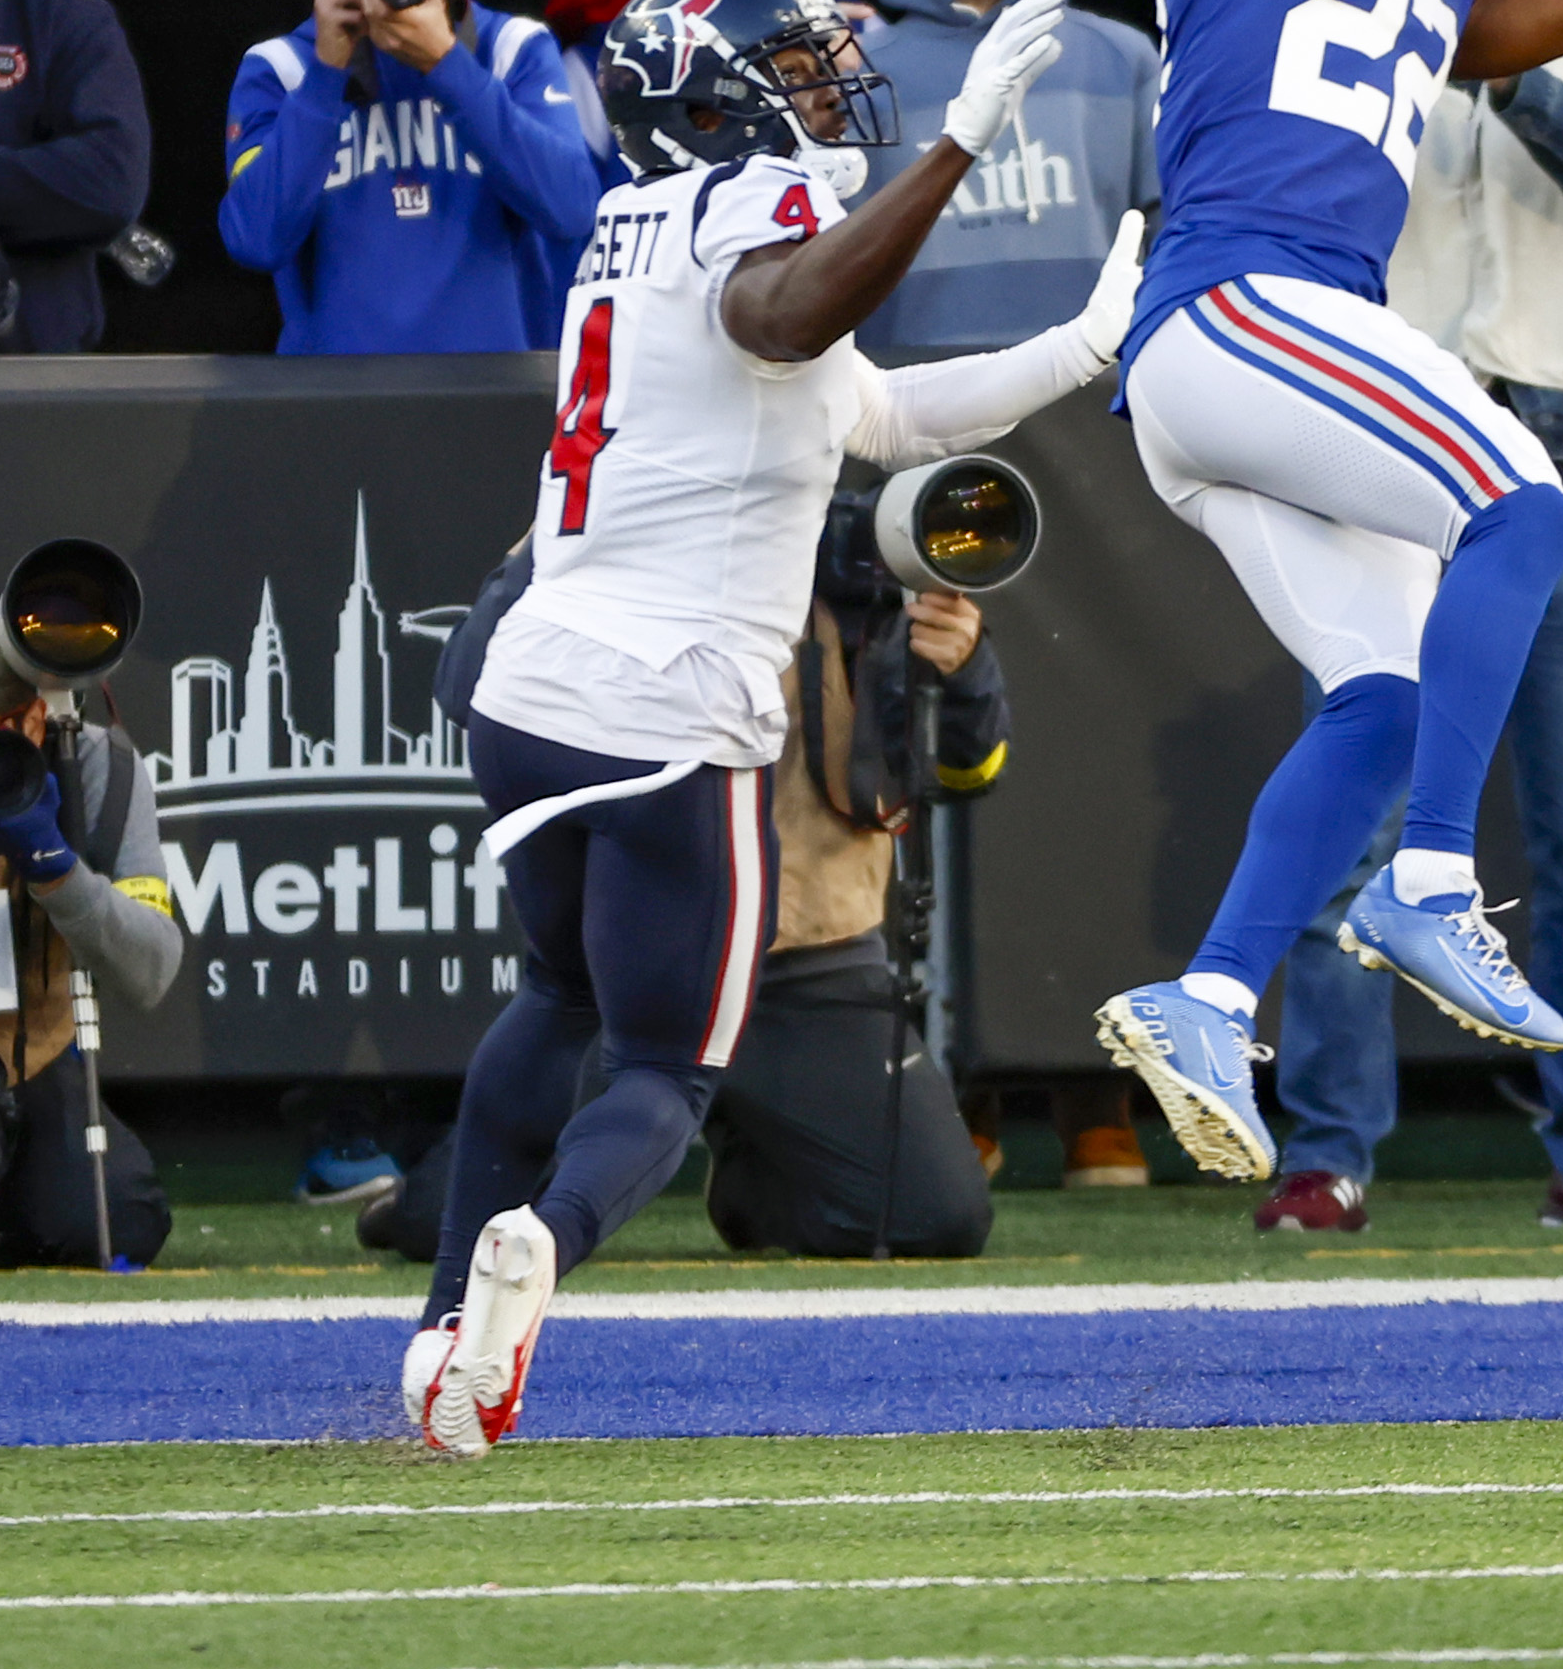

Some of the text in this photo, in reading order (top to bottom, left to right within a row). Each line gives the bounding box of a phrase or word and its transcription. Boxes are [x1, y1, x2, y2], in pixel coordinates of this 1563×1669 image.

[322, 98, 484, 190] GIANT
[391, 183, 432, 219] ny
[771, 182, 822, 240] 4
[574, 212, 669, 286] SETT
[550, 297, 619, 537] 4
[159, 822, 509, 937] MetLif
[206, 954, 520, 1000] STADIUM
